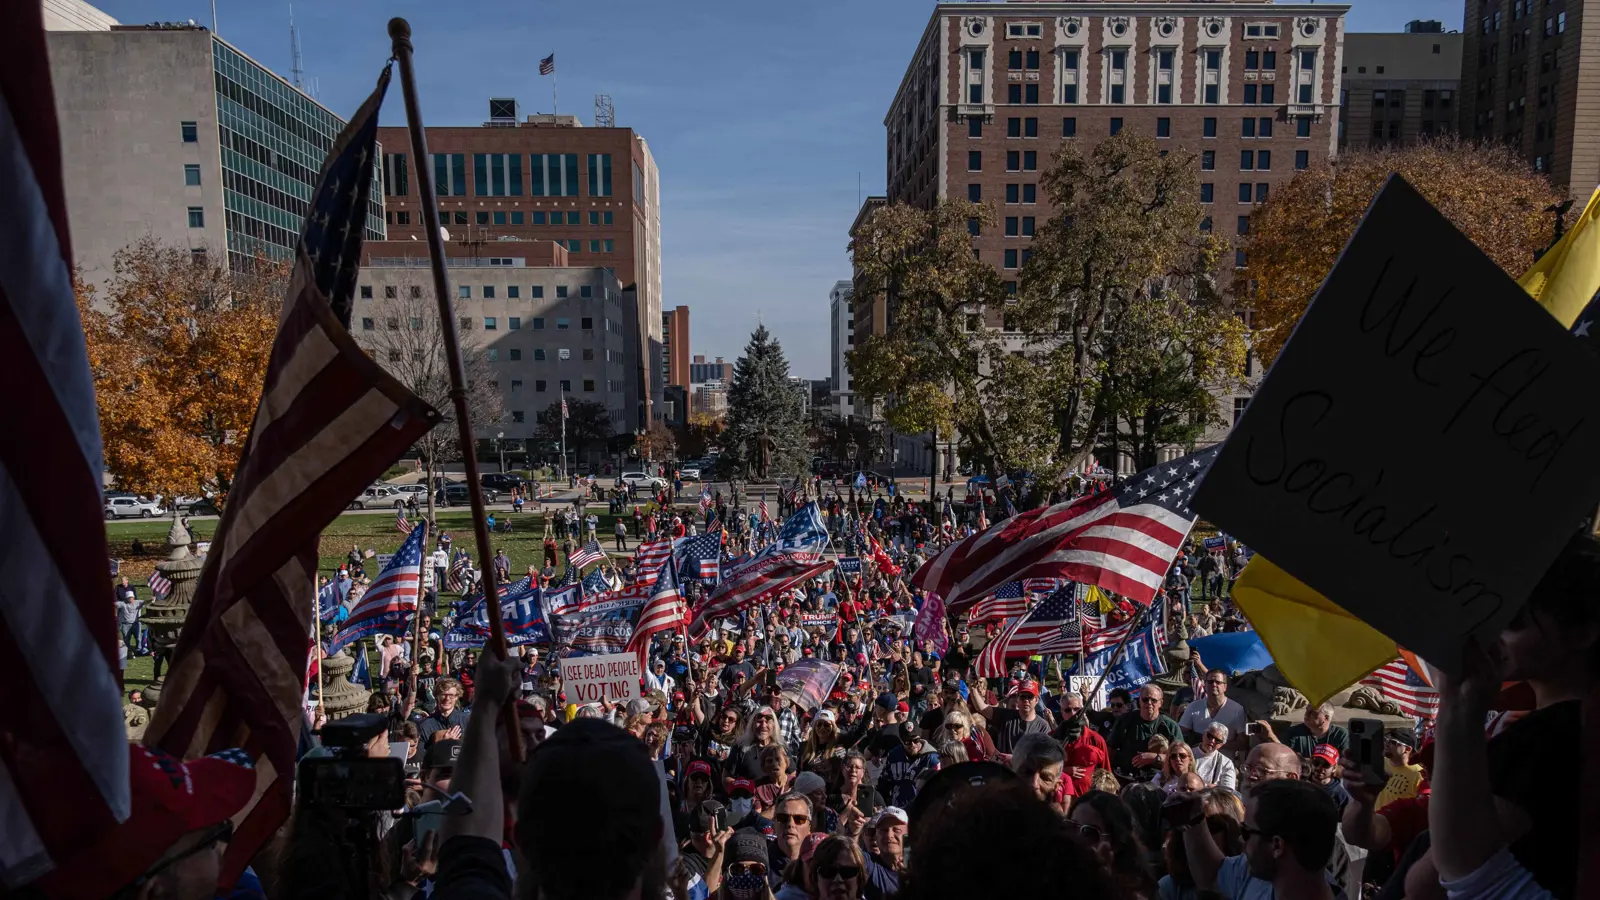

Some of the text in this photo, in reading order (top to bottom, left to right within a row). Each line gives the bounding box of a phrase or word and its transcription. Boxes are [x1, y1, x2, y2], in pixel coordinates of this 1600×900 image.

[1359, 254, 1586, 495] We fled
[1245, 388, 1504, 637] Socialism
[563, 660, 638, 681] I SEE DEAD PEOPLE
[575, 680, 630, 702] VOTING
